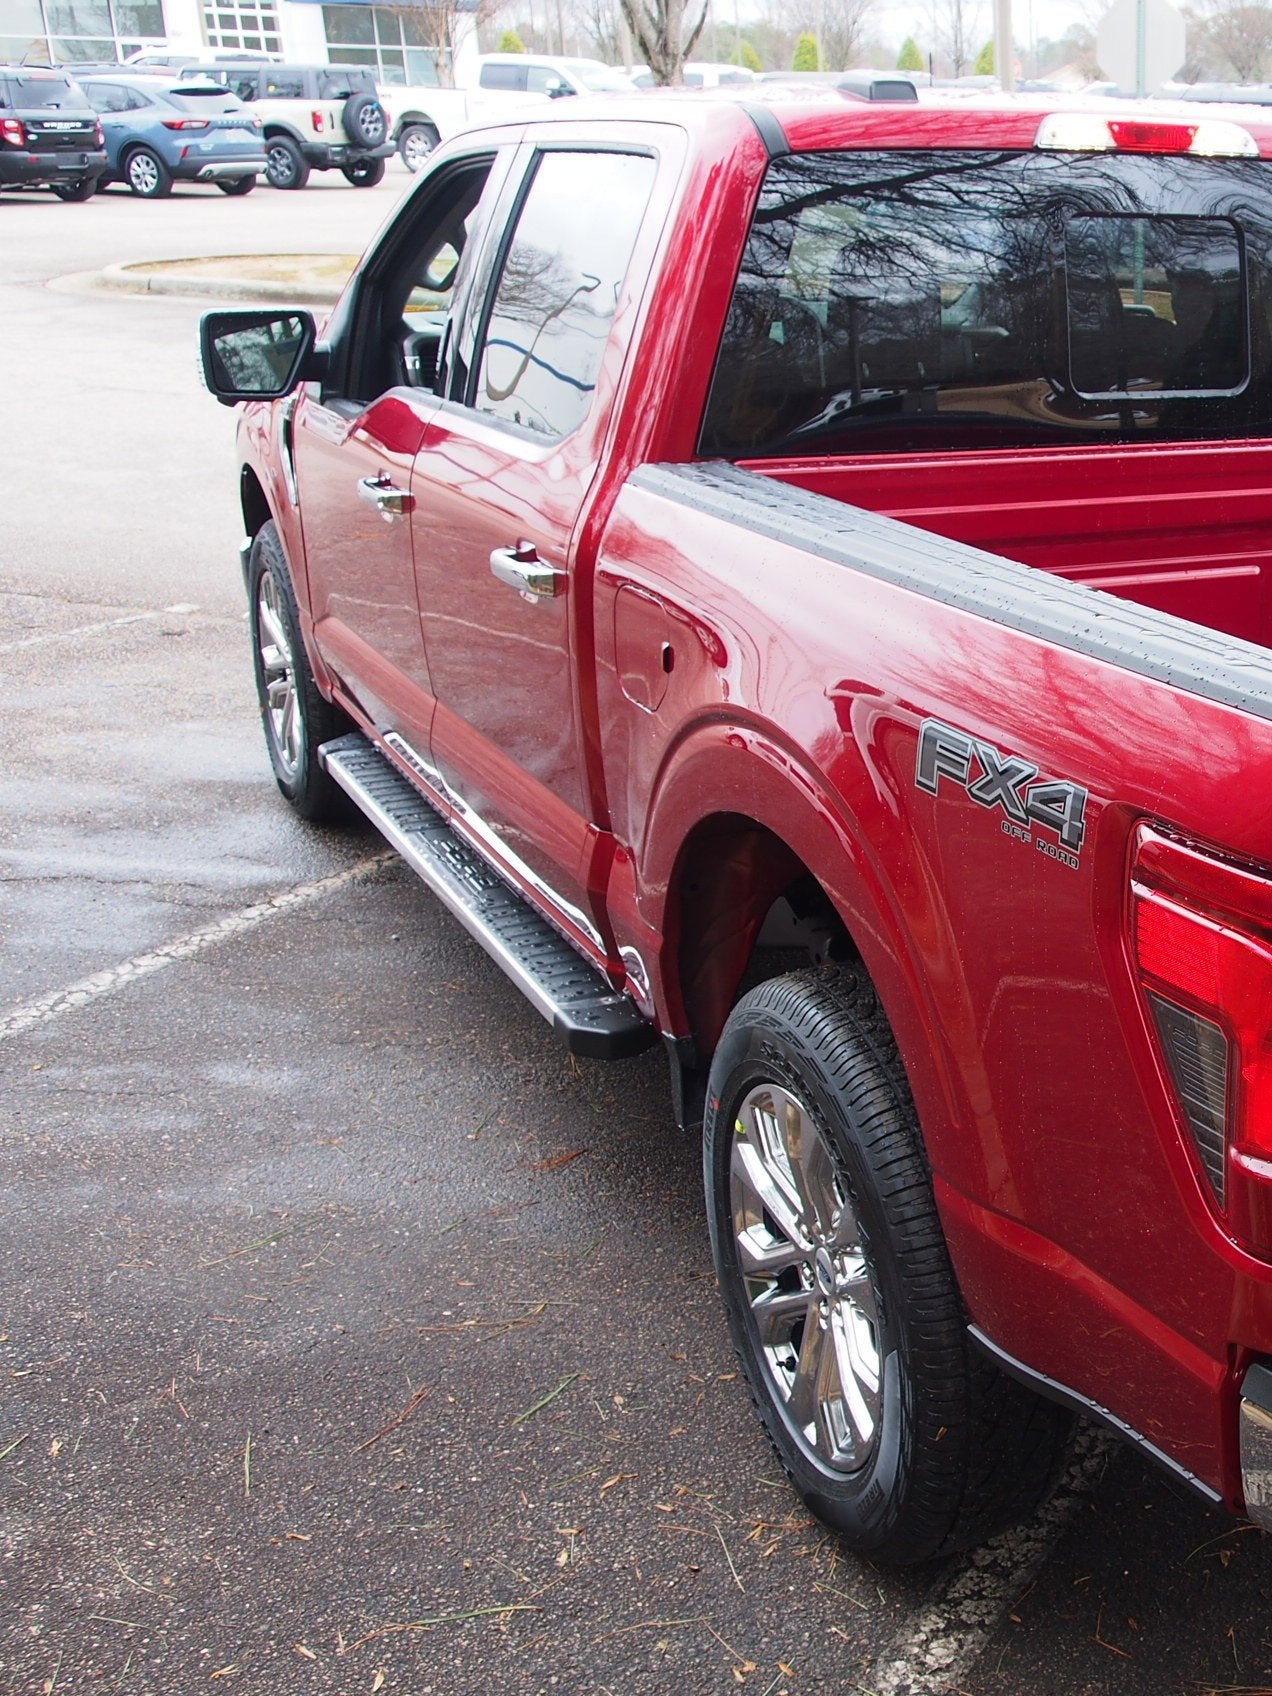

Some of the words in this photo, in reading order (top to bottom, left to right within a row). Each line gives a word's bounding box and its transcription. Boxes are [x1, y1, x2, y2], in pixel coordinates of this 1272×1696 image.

[915, 717, 1089, 855] FX4
[1001, 821, 1031, 842] OFF
[1036, 838, 1079, 870] ROAD
